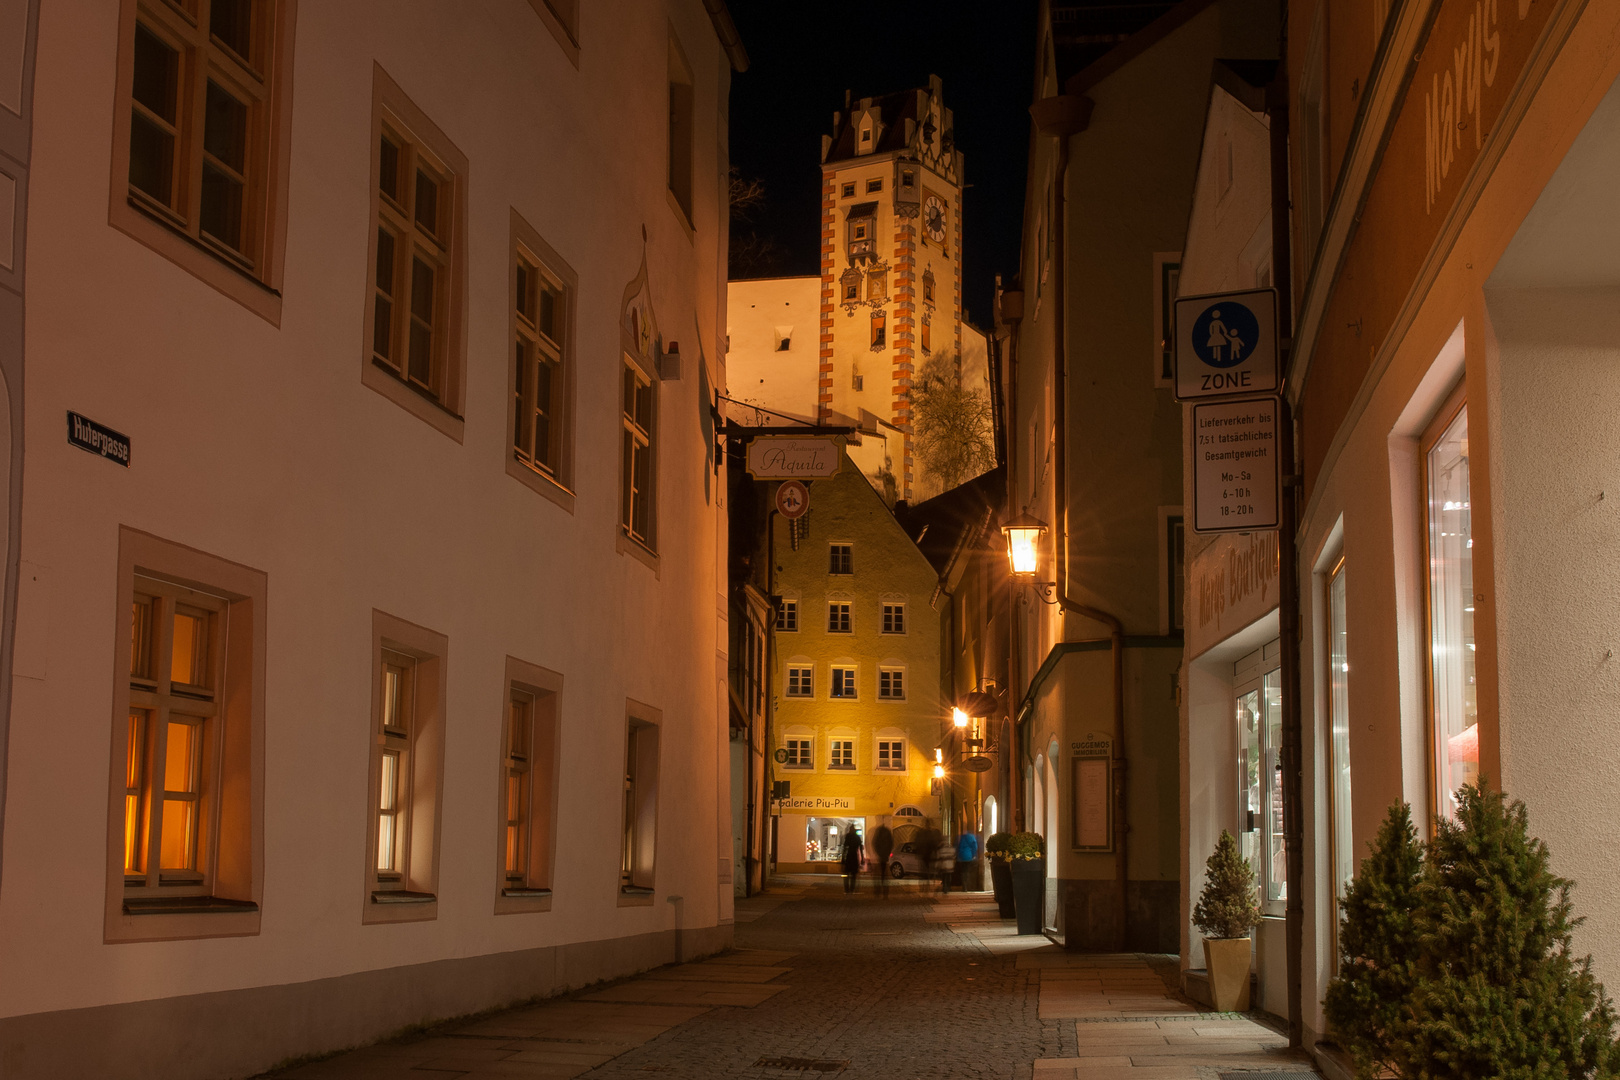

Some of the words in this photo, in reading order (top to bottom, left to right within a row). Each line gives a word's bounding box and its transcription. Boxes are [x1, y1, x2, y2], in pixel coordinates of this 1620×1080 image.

[1201, 370, 1252, 391] ZONE
[1200, 415, 1255, 428] Lieferverkehr
[1259, 413, 1272, 423] bis
[73, 415, 128, 461] Hutergasse
[1199, 434, 1210, 446] 7,5
[1211, 434, 1216, 444] t
[1218, 431, 1273, 443] tatsächliches
[760, 447, 824, 473] Aquila
[1205, 448, 1267, 461] Gesamtgewicht
[1071, 741, 1109, 749] GUGGEMOS
[778, 798, 813, 808] Galerie
[816, 798, 849, 808] Piu-Piu
